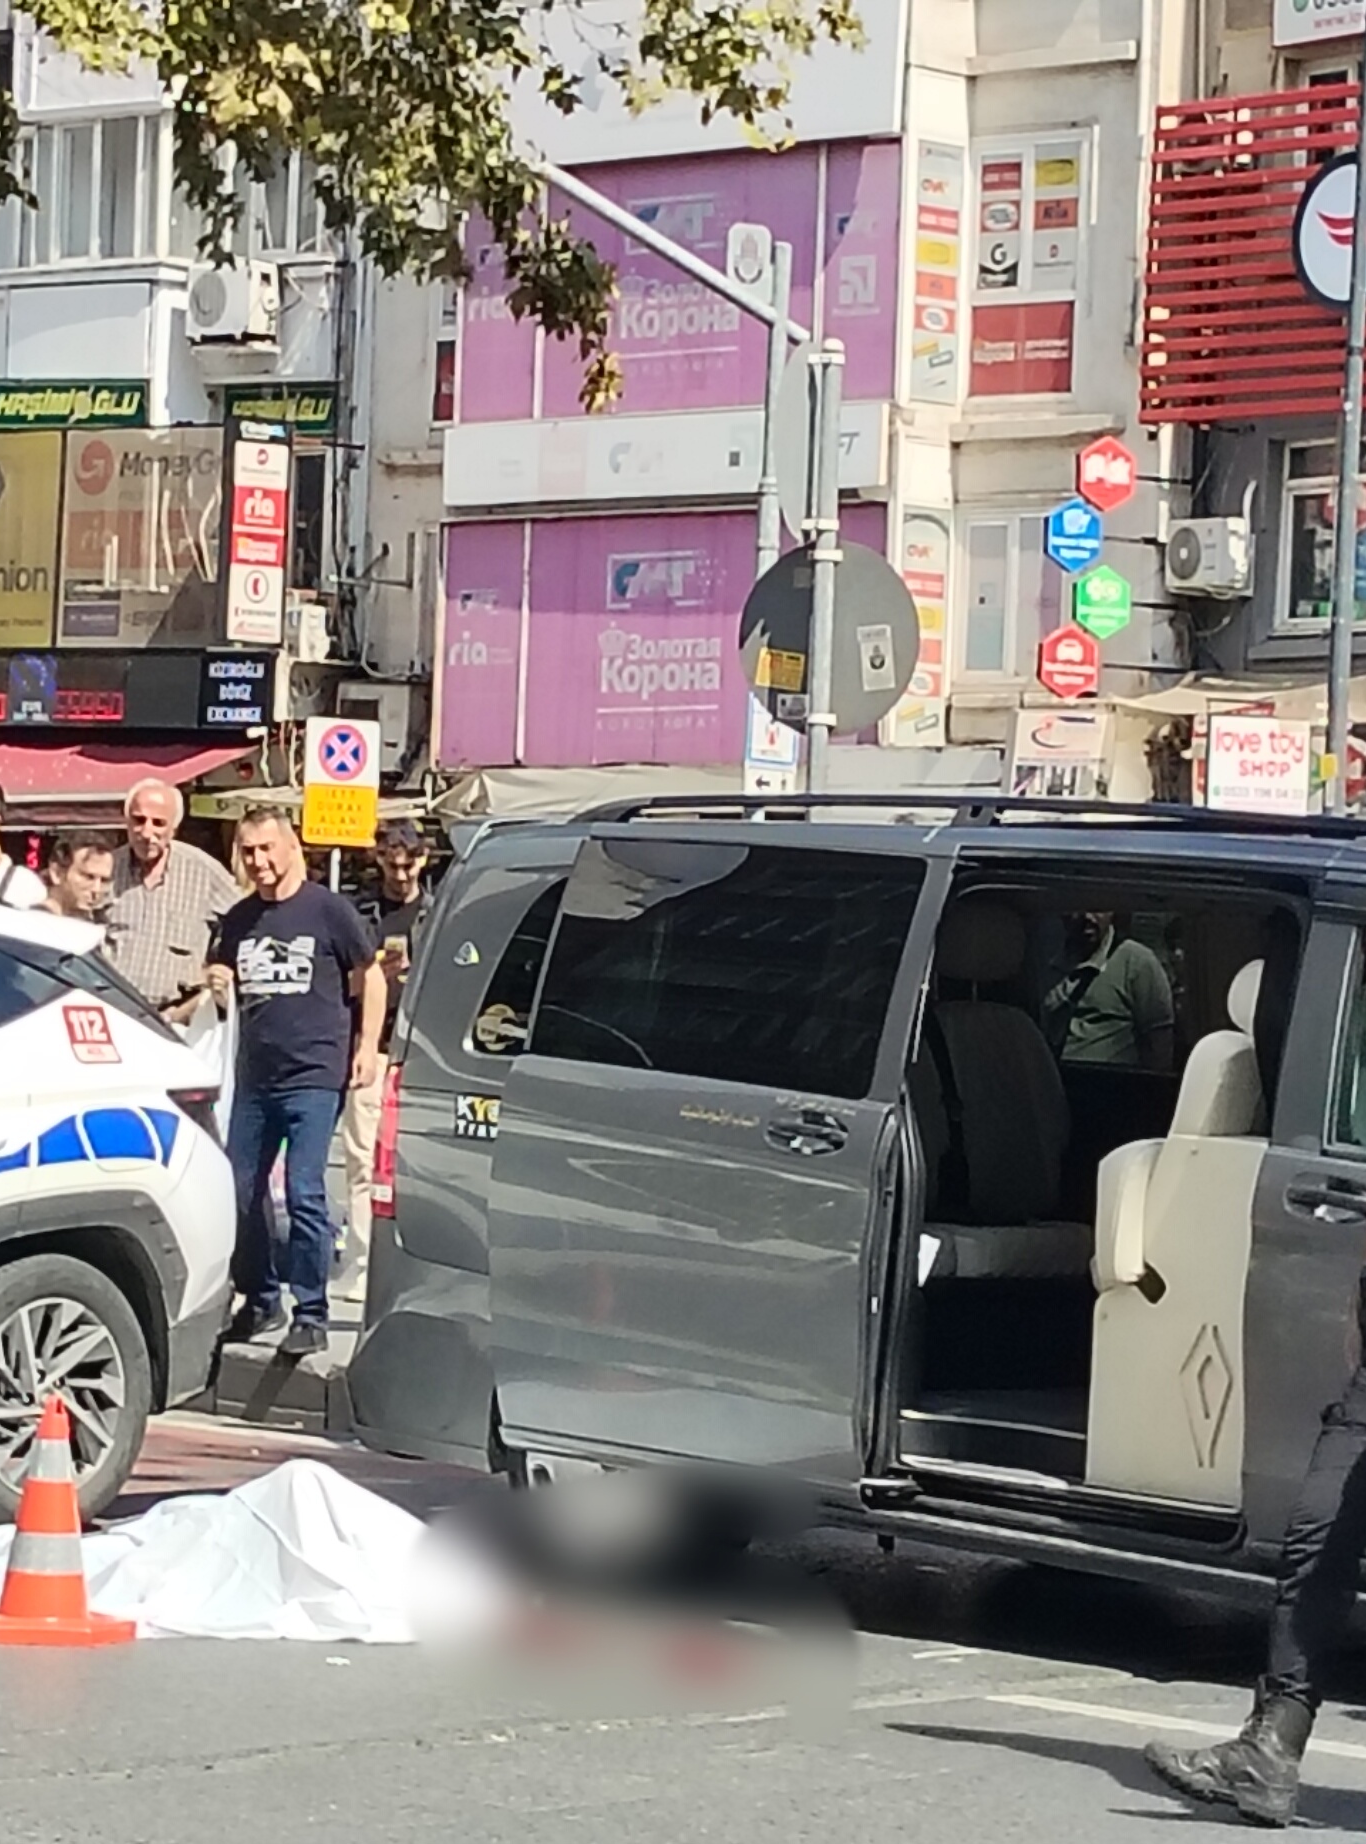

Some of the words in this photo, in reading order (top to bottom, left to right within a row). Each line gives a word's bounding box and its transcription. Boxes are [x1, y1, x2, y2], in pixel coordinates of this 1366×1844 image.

[619, 300, 740, 342] Корона
[243, 489, 276, 519] ria
[446, 630, 489, 667] ria
[627, 634, 722, 660] Золотая
[599, 658, 721, 700] Корона
[1215, 726, 1262, 754] love
[1268, 728, 1305, 764] toy
[1239, 759, 1291, 778] SHOP
[68, 1009, 109, 1042] 112
